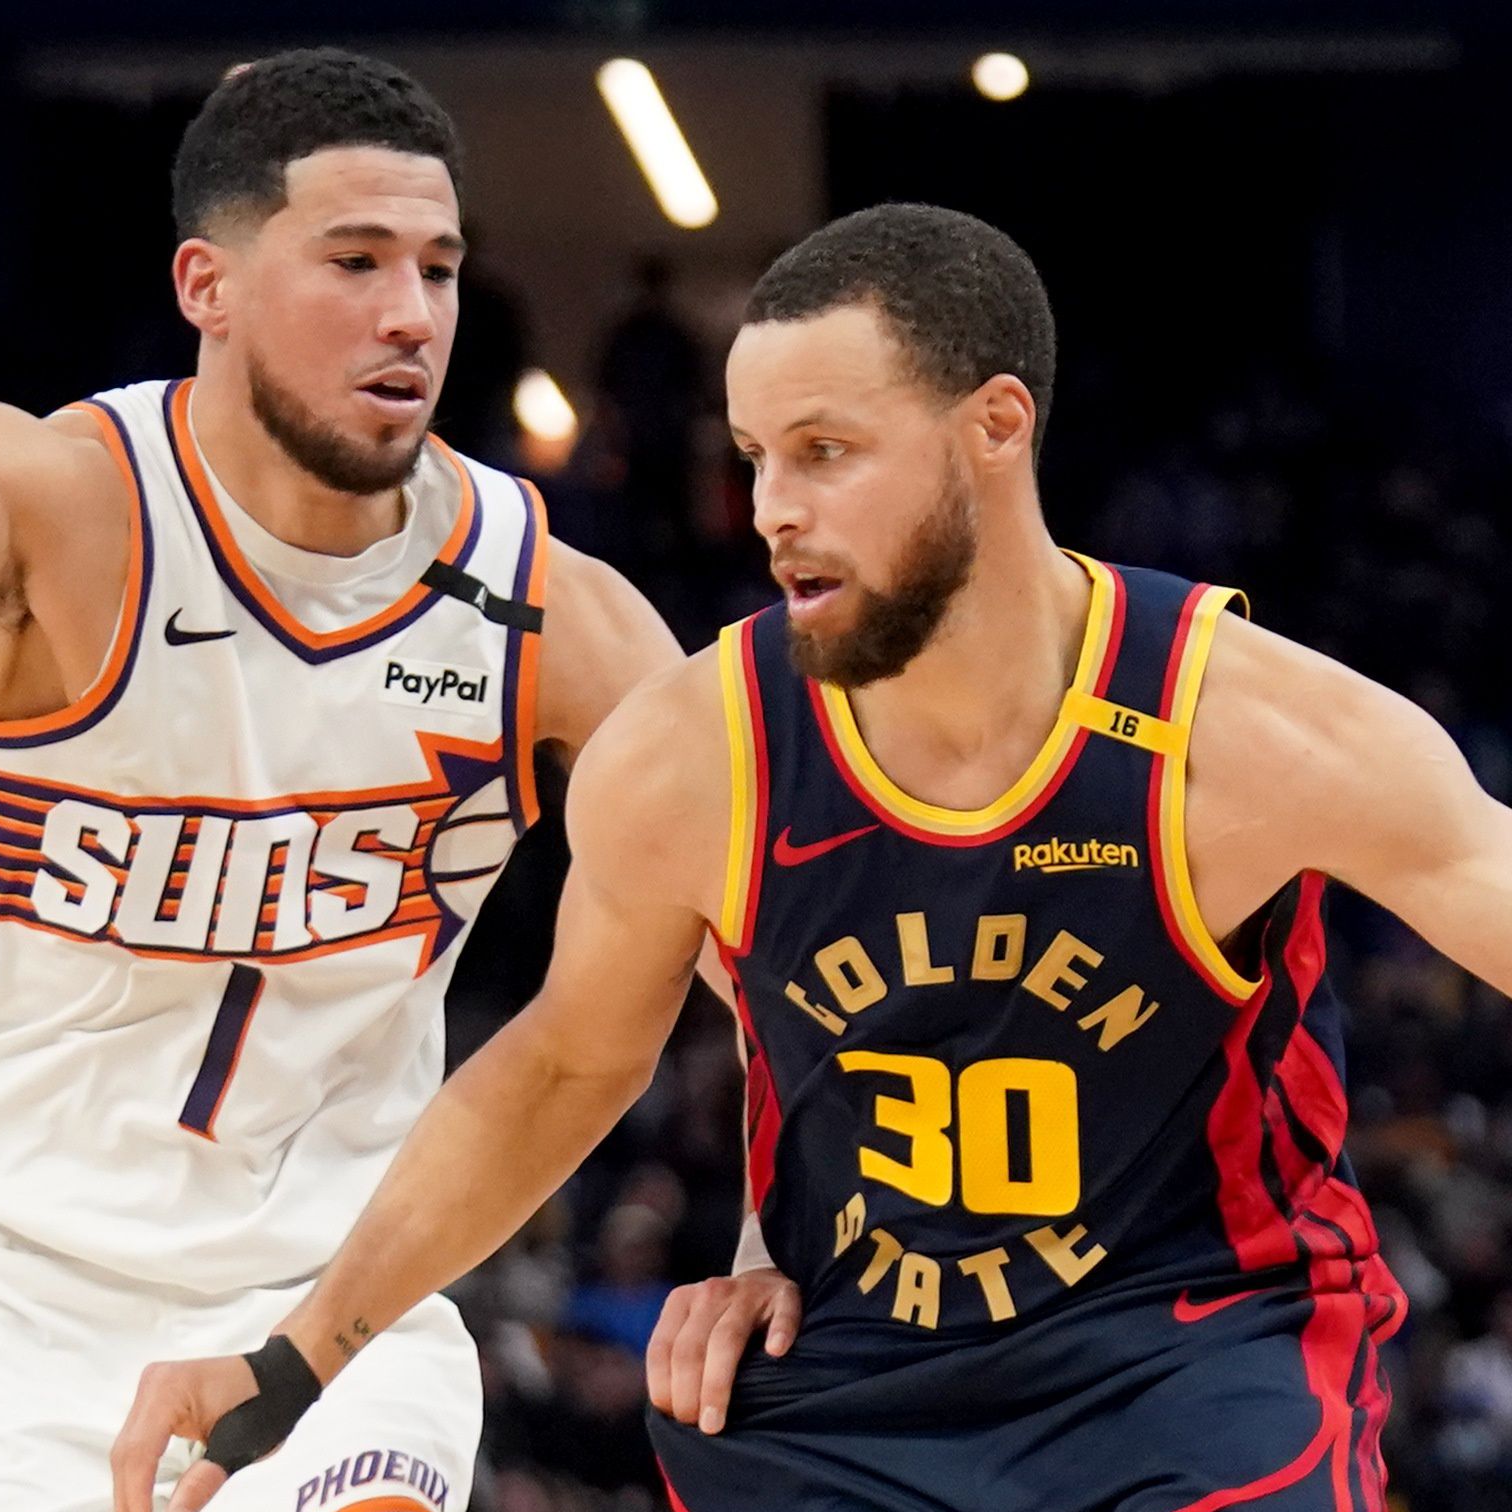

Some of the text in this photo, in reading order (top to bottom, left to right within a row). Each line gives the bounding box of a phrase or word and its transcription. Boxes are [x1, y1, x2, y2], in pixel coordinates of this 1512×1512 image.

[385, 661, 488, 704] PayPal
[1110, 711, 1140, 737] 16
[29, 799, 420, 952] SUNS
[1014, 836, 1138, 873] Rakuten
[178, 961, 267, 1142] 1
[835, 1050, 1081, 1217] 30
